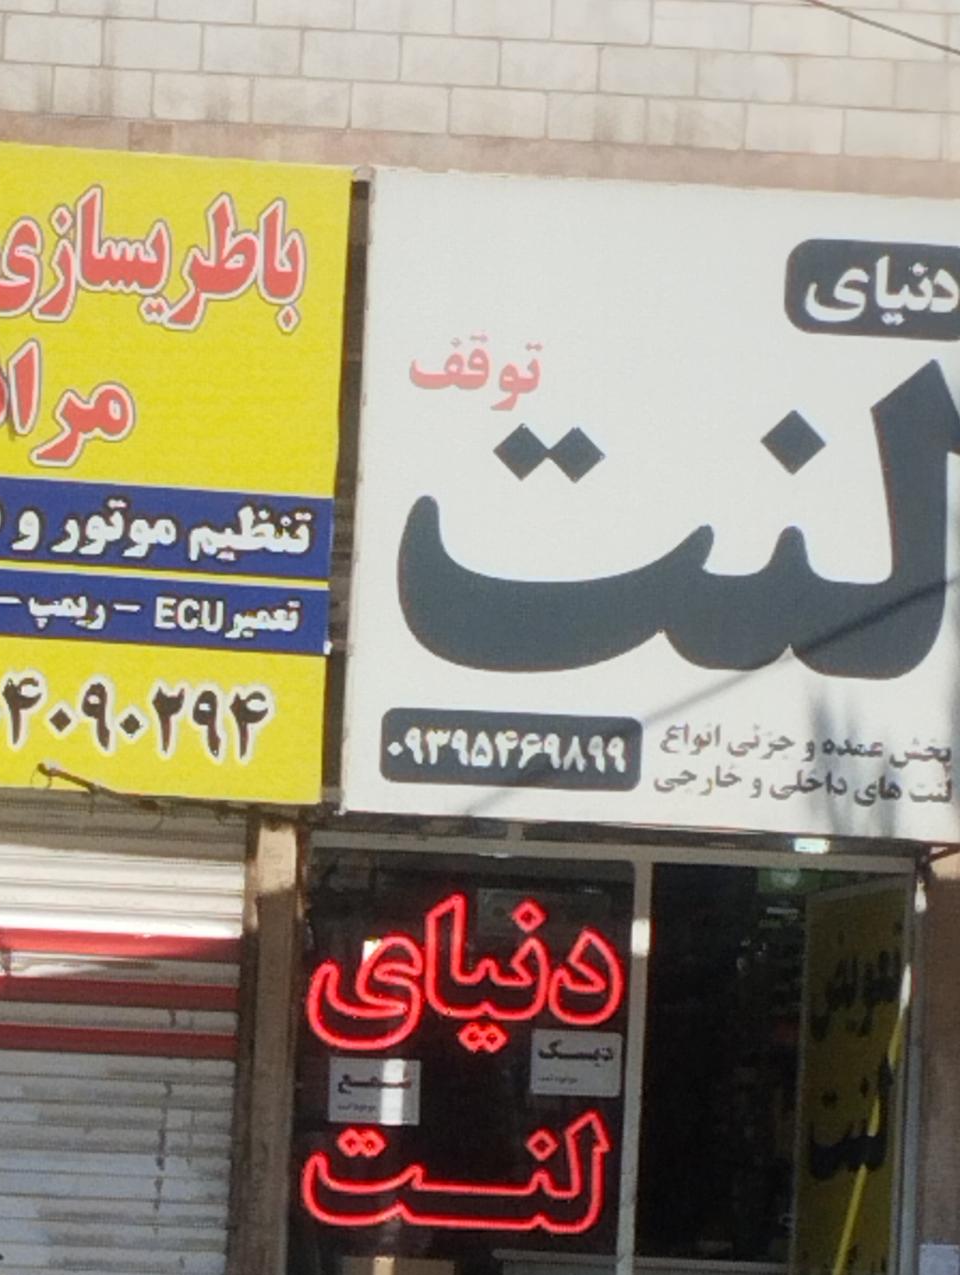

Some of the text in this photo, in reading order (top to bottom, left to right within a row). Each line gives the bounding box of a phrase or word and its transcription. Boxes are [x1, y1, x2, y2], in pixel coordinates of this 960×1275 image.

[804, 255, 960, 325] دنیای
[408, 331, 543, 411] توقف
[11, 510, 40, 550] و
[50, 498, 177, 557] موتور
[189, 505, 312, 561] تنظیم
[397, 358, 960, 680] لنت
[27, 596, 107, 630] ریمپ
[154, 596, 224, 632] ECU
[225, 600, 301, 638] تعمیر
[659, 722, 722, 755] انواع
[801, 736, 815, 762] و
[821, 737, 884, 758] عمده
[890, 737, 952, 770] پخش
[653, 763, 743, 796] خارجی
[749, 775, 763, 798] و
[769, 767, 848, 801] داخلی
[853, 772, 902, 806] های
[307, 892, 625, 1054] دنیای
[302, 1109, 612, 1234] لنت
